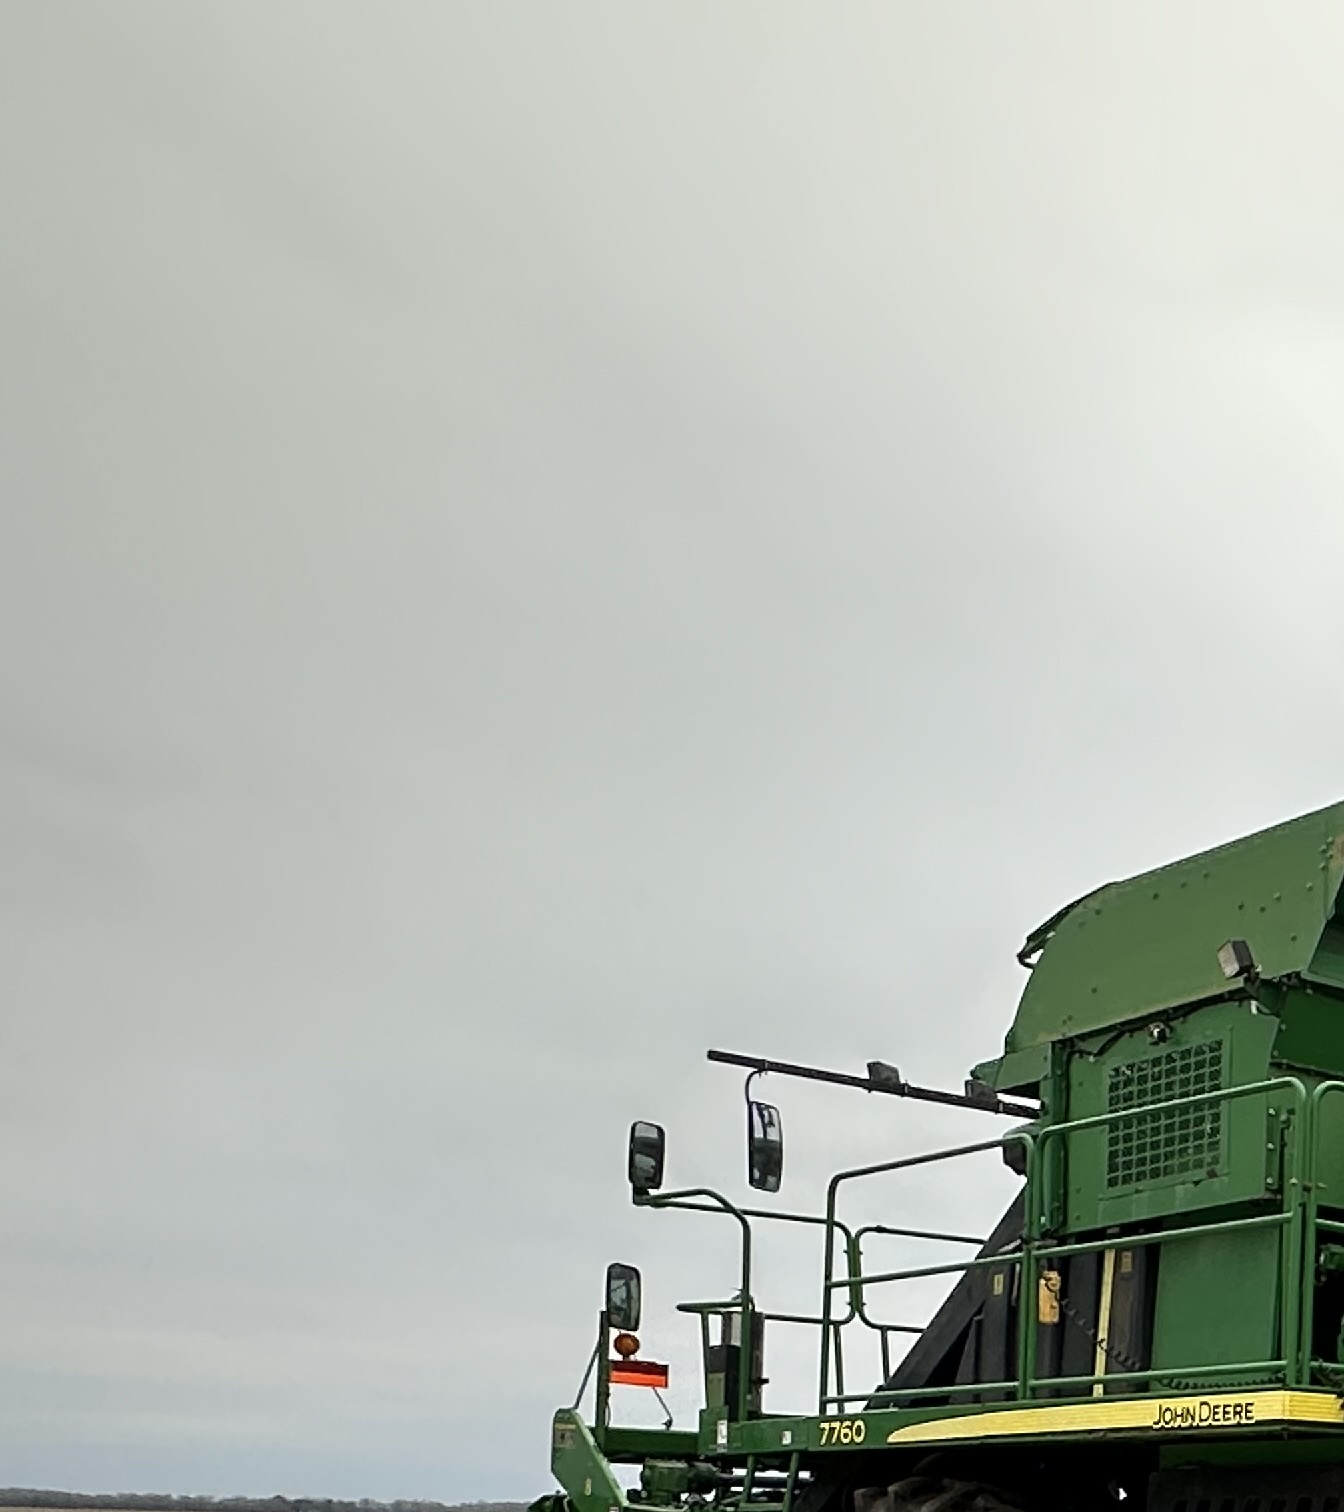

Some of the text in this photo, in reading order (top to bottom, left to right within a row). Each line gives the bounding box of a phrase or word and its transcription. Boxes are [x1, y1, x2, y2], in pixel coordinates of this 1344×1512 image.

[1152, 1400, 1255, 1426] JOHN DEERE
[819, 1419, 866, 1446] 7760
